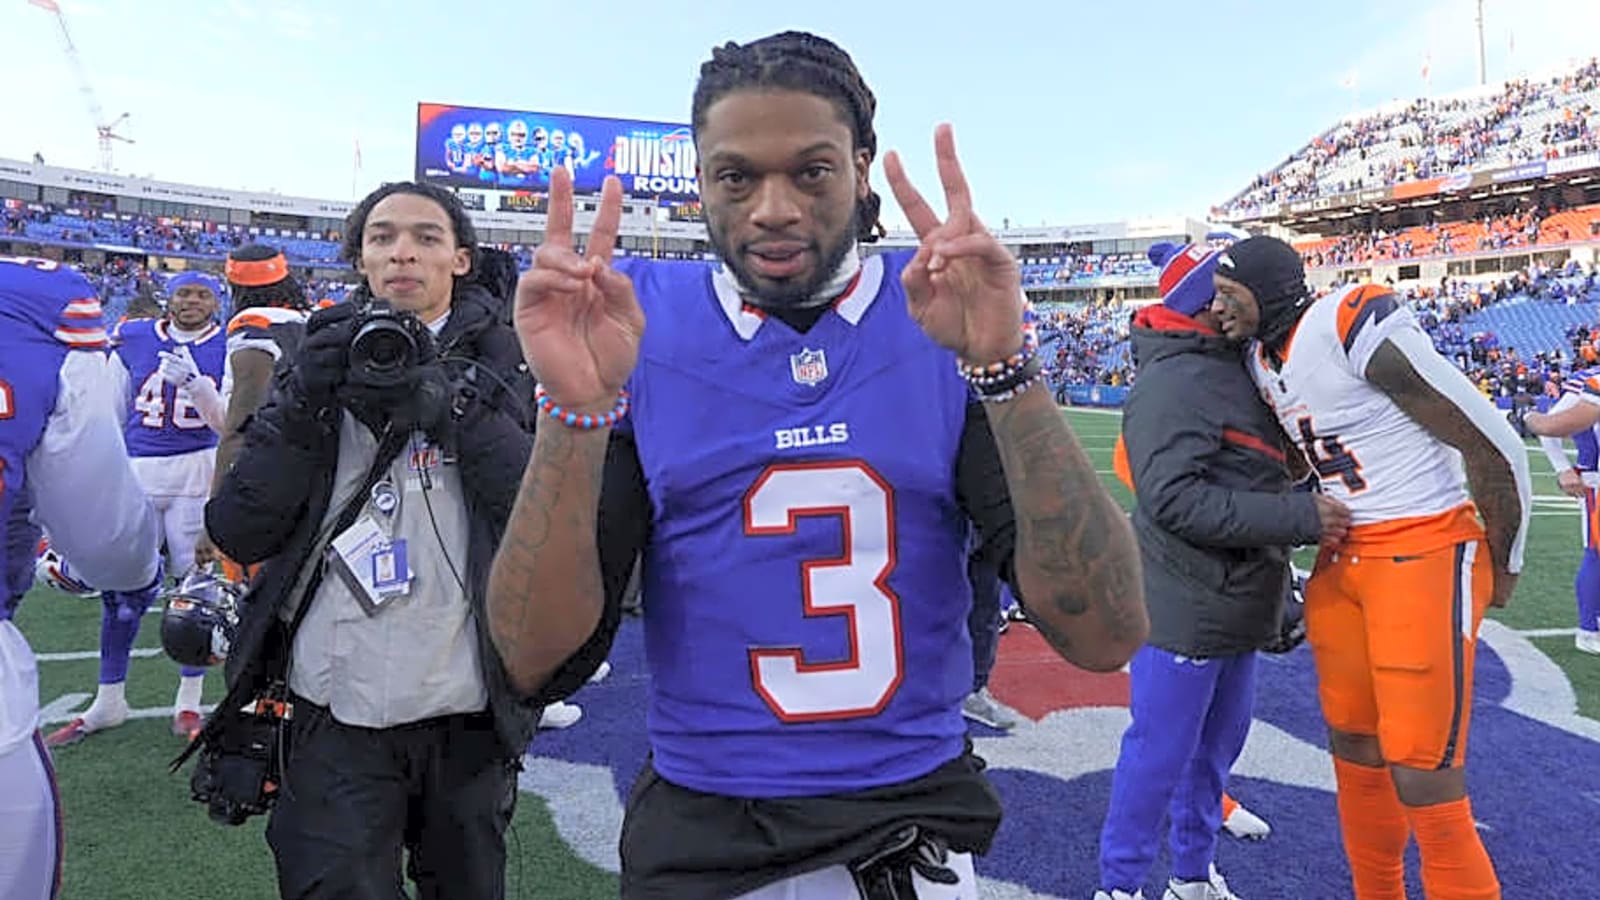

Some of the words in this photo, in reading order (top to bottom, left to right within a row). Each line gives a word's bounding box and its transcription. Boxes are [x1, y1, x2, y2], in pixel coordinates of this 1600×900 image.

[633, 176, 700, 195] ROUN
[774, 423, 849, 449] BILLS
[743, 459, 903, 722] 3
